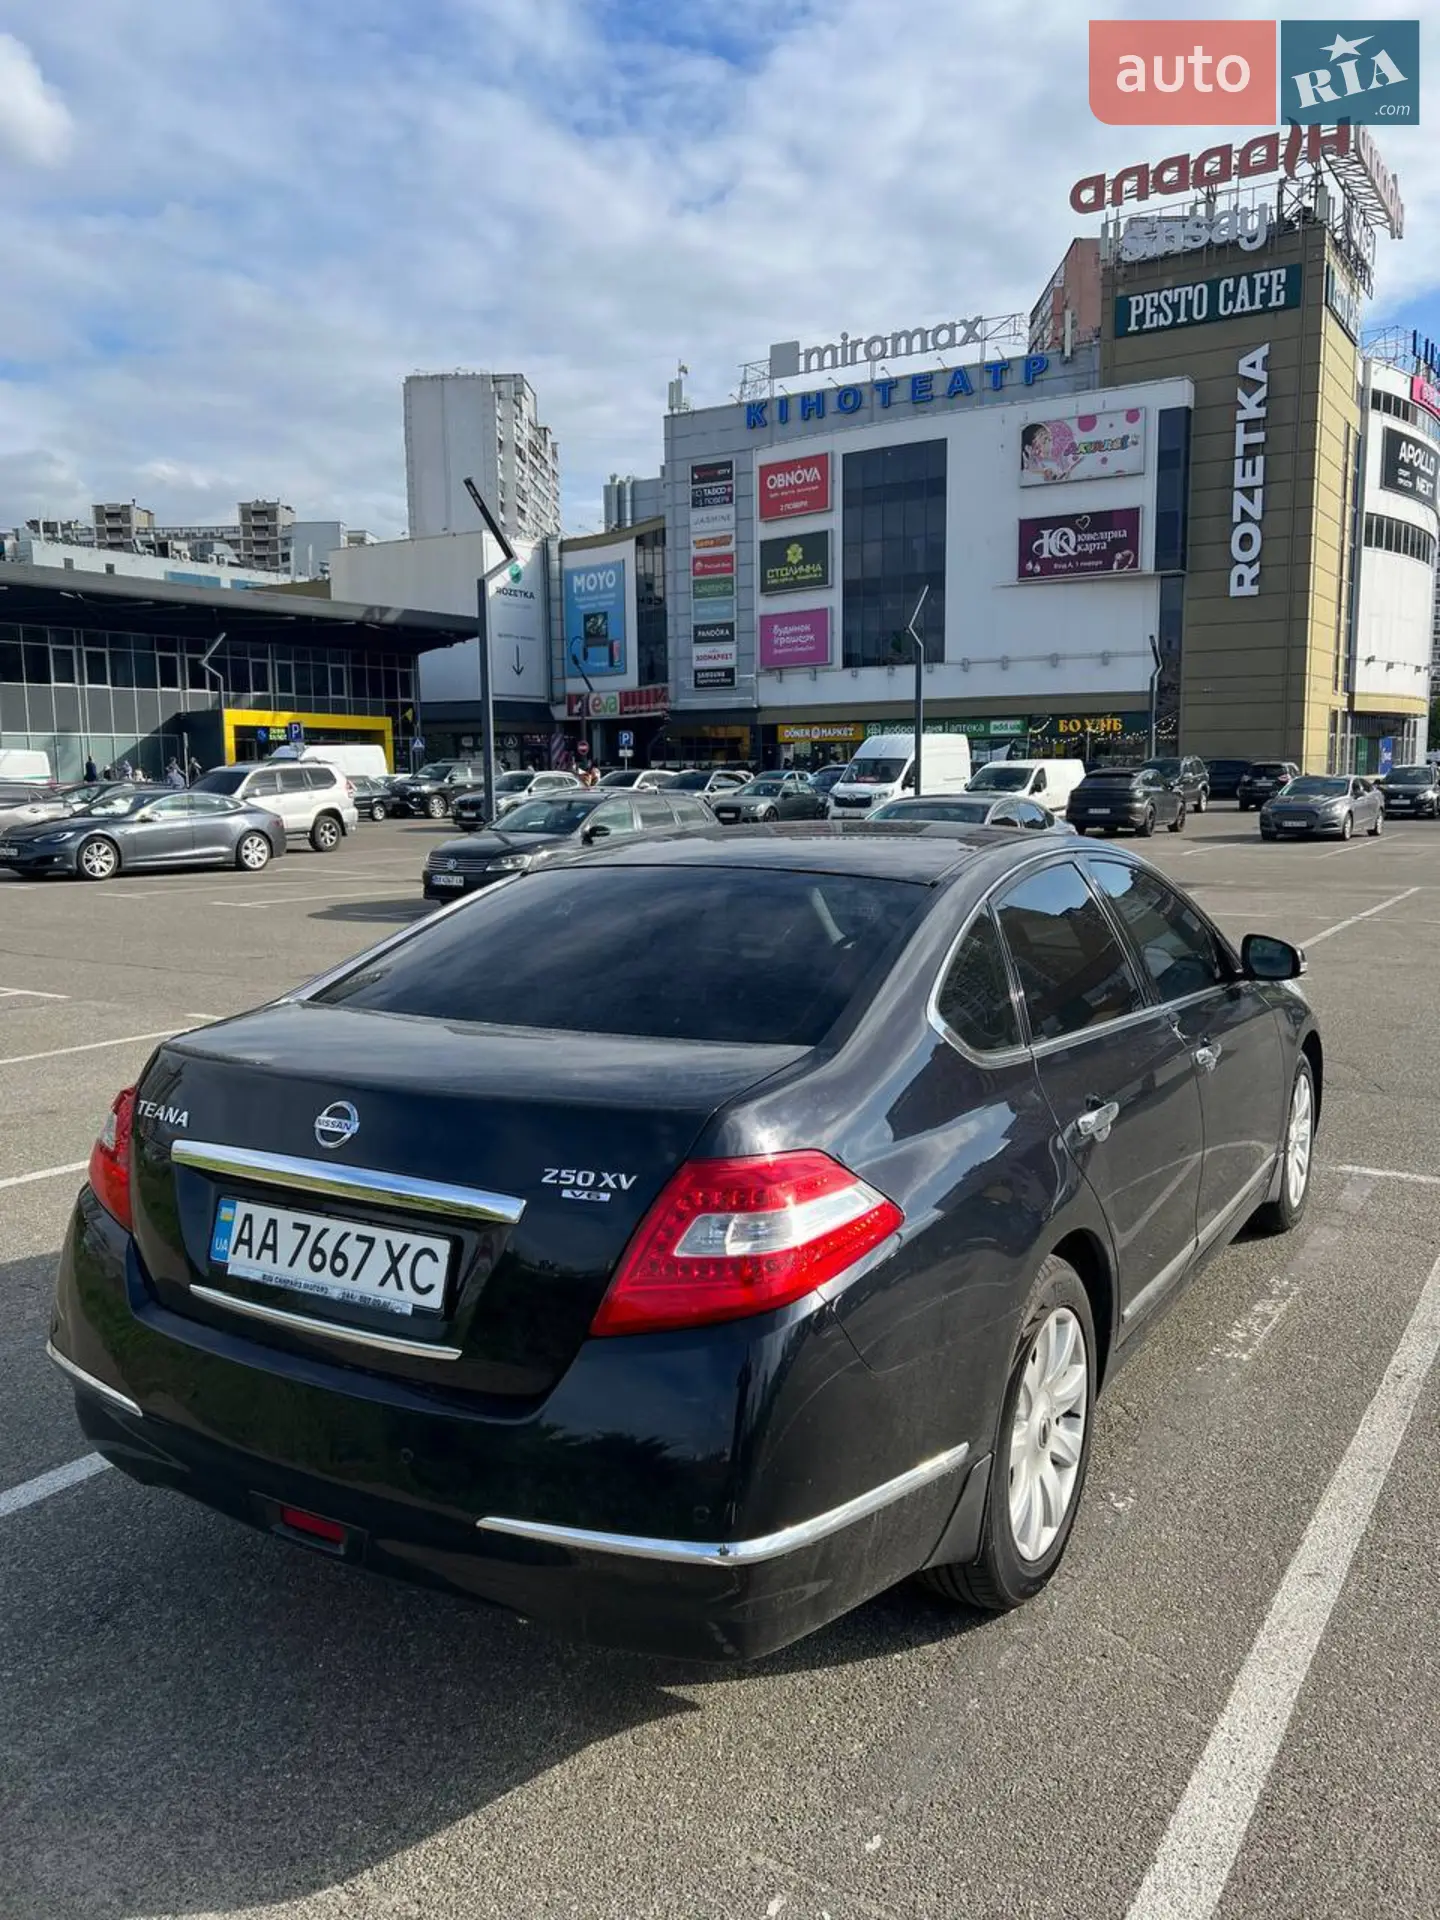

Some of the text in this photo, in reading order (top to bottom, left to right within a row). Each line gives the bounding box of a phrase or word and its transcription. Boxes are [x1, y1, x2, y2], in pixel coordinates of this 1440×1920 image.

[1128, 282, 1208, 333] PESTO
[1219, 268, 1287, 317] CAFE
[803, 315, 983, 374] miromax
[746, 353, 1050, 430] КІНОТЕАТР
[1229, 343, 1270, 598] ROZETKA
[1399, 441, 1435, 476] APOLLO
[573, 569, 616, 594] MOYO
[591, 695, 618, 713] eva
[137, 1100, 190, 1128] TEANA
[317, 1118, 352, 1131] NISSAN
[540, 1167, 638, 1191] 250 XV
[214, 1238, 228, 1252] UA
[231, 1212, 439, 1295] AA 7667 XC
